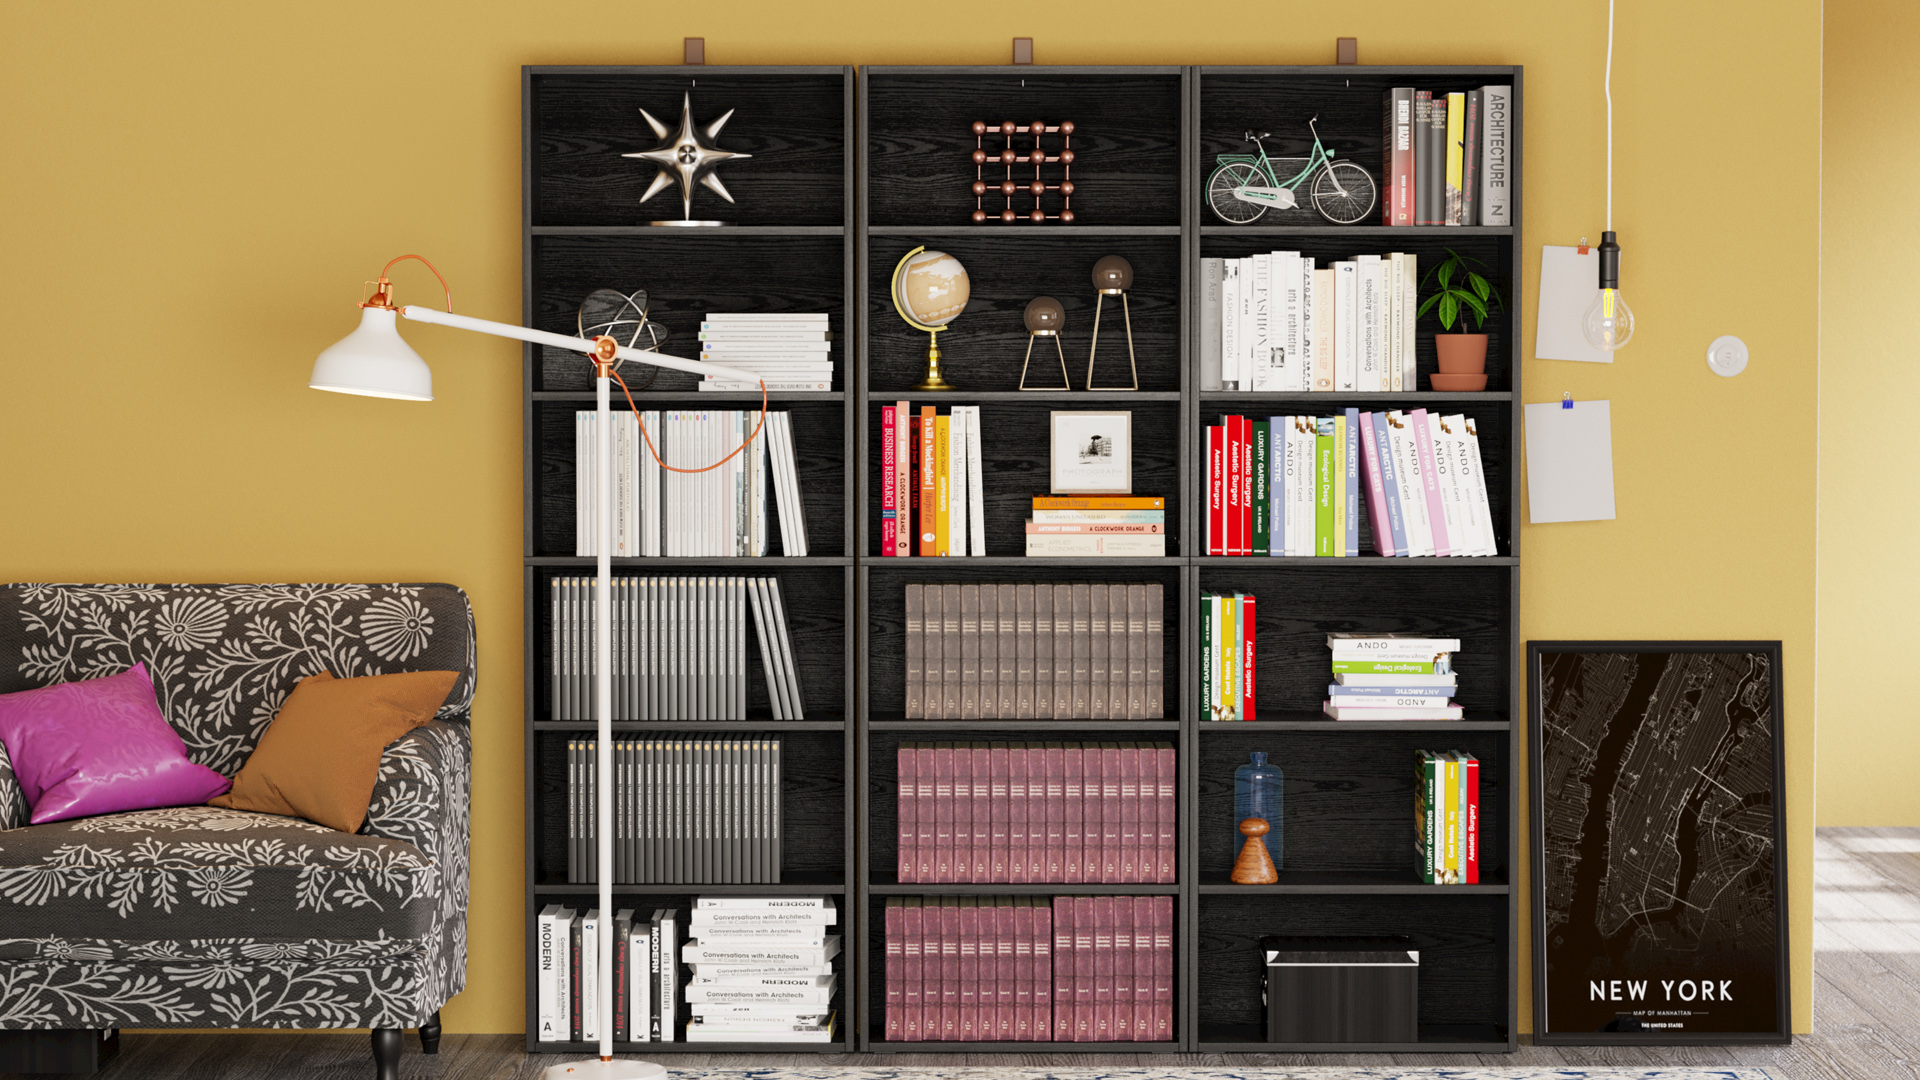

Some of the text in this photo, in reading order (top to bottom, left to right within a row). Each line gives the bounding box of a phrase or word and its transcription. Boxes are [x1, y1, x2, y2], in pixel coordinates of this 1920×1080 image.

[1398, 100, 1410, 151] BHENDI BAZAAR
[1490, 94, 1505, 188] ARCHITECTURE
[1208, 262, 1217, 279] Ron
[1208, 281, 1217, 301] Arad
[1257, 288, 1267, 346] FASHION
[1257, 350, 1267, 388] BOOK
[925, 417, 933, 426] To
[885, 428, 893, 507] BUSINESS RESEARCH
[923, 445, 933, 485] Mockingbird
[1365, 426, 1375, 455] LUXURY
[1372, 472, 1382, 493] CATS
[1378, 430, 1393, 481] ANTARCTIC
[1394, 436, 1402, 456] Design
[1398, 457, 1407, 484] museum
[1408, 441, 1420, 476] ANDO
[1418, 424, 1428, 454] LUXURY
[1426, 471, 1435, 492] CATS
[1434, 440, 1446, 475] ANDO
[1458, 441, 1469, 476] ANDO
[1072, 500, 1090, 509] Orange
[1230, 474, 1239, 506] Surgery
[1244, 477, 1252, 508] Surgery
[924, 514, 932, 524] Lee
[543, 924, 551, 970] MODERN
[1590, 980, 1733, 1001] NEW YORK
[544, 1022, 552, 1031] A
[653, 1022, 659, 1031] A
